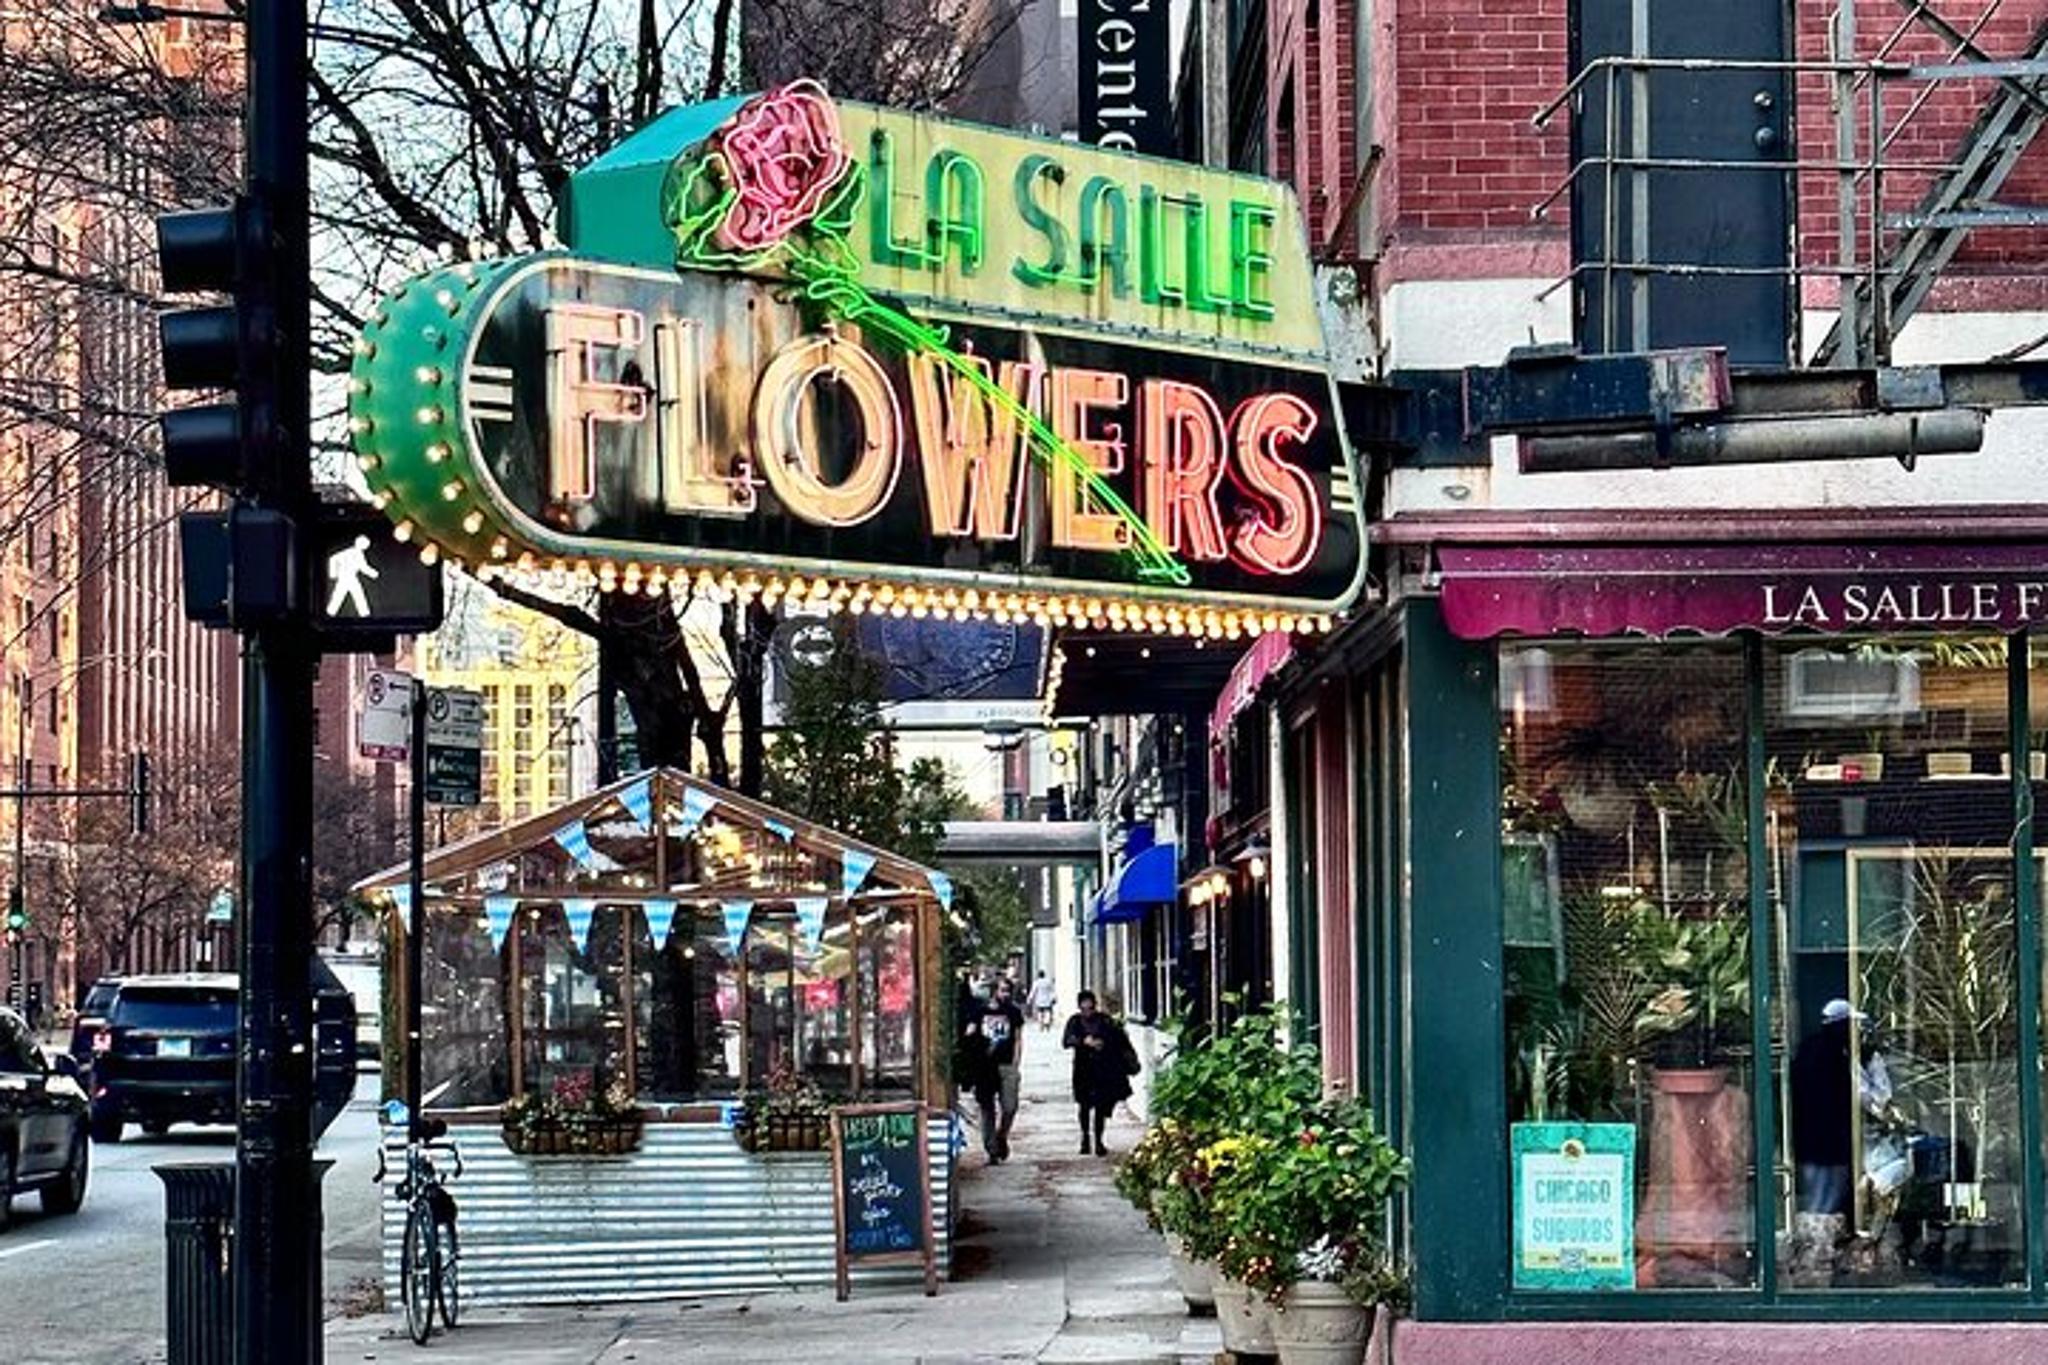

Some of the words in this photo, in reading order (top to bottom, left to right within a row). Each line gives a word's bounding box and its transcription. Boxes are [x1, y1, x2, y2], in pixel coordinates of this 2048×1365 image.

[869, 127, 985, 277] LA
[1012, 153, 1277, 321] SALLE
[543, 302, 1322, 576] FLOWERS
[1762, 584, 1829, 622] LA
[1843, 583, 2002, 623] SALLE
[2014, 582, 2048, 622] F
[1535, 1179, 1611, 1204] CHICAGO
